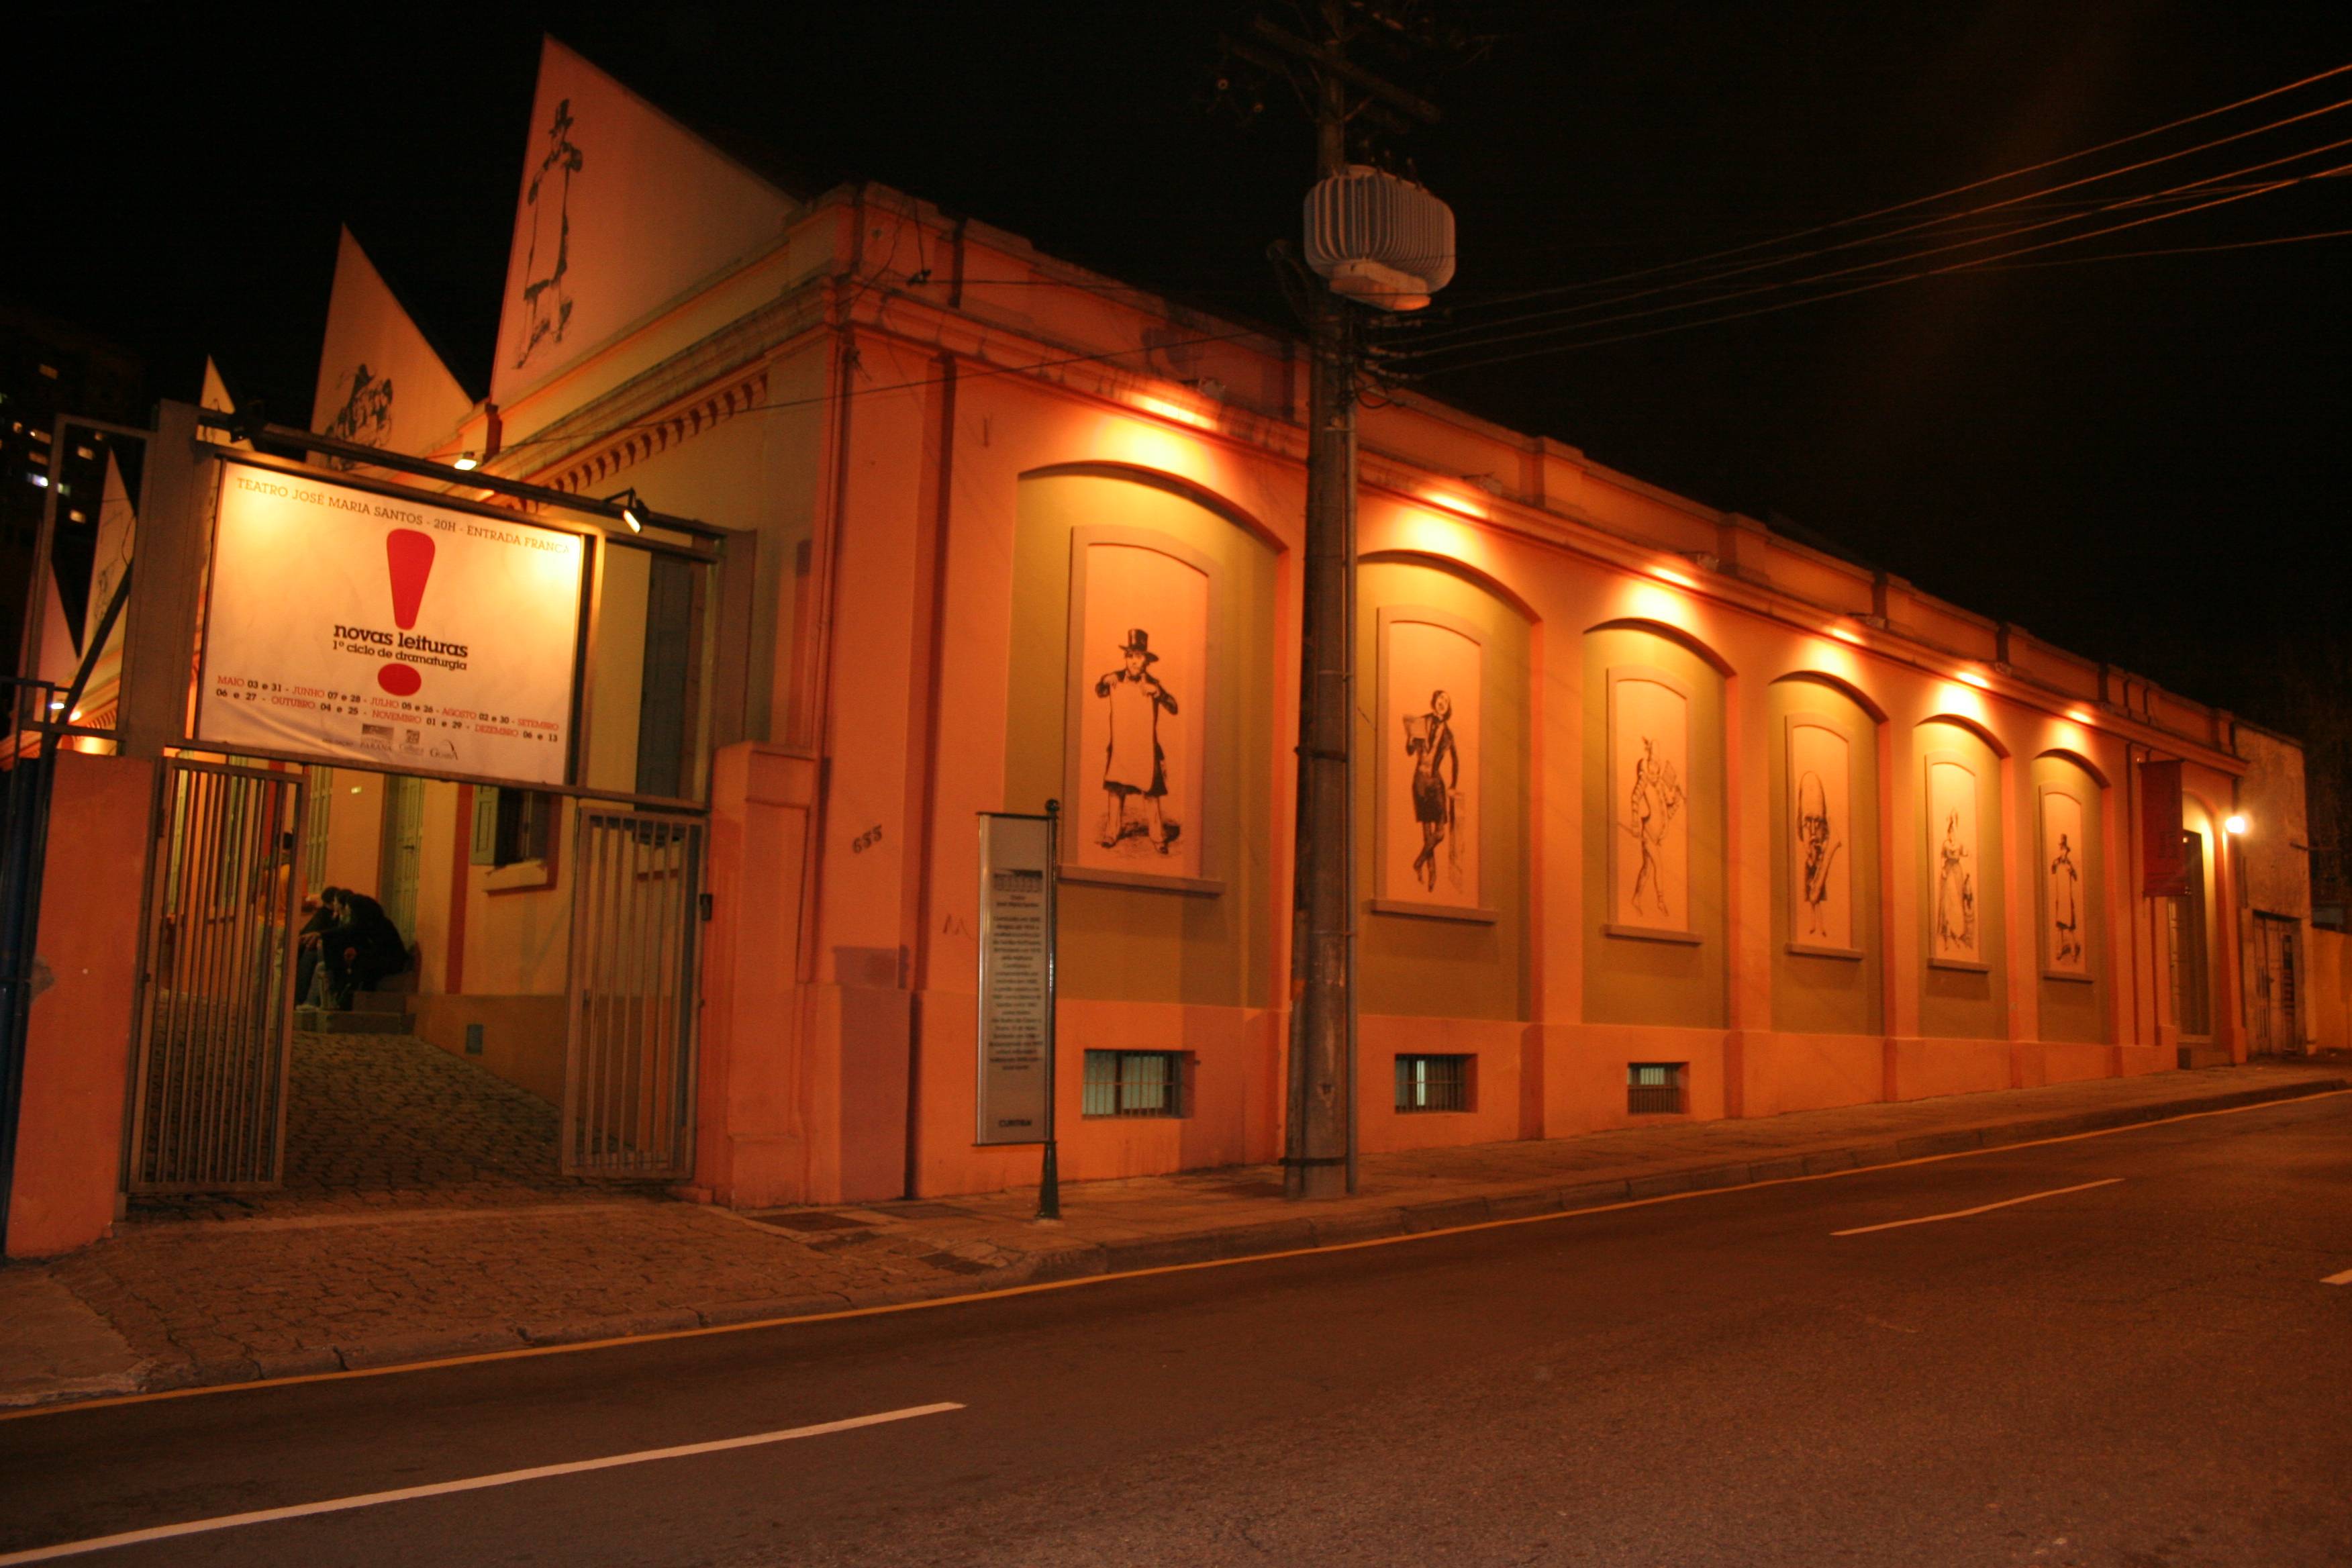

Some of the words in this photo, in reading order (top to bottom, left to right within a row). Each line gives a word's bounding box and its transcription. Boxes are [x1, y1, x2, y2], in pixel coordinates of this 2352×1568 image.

[237, 477, 289, 497] TEATRO
[292, 489, 325, 505] JOSÉ
[328, 497, 371, 515] MARIA
[373, 506, 424, 525] SANTOS
[434, 519, 456, 532] 20H
[467, 525, 521, 546] ENTRADA
[524, 537, 569, 554] FRANCA
[333, 624, 393, 646] novas
[398, 632, 469, 657] leituras
[346, 643, 375, 656] ciclo
[377, 648, 393, 658] de
[395, 650, 467, 671] dramaturgia
[215, 689, 228, 697] 06
[245, 692, 257, 701] 27
[271, 695, 316, 709] OUTUBRO
[320, 703, 332, 712] 04
[372, 710, 422, 725] NOVEMBRO
[426, 718, 436, 726] 01
[475, 724, 519, 738] DEZEMBRO
[522, 731, 532, 740] 06
[548, 734, 558, 742] 13
[217, 675, 245, 687] MAIO
[247, 679, 258, 689] 03
[271, 683, 282, 692] 31
[292, 686, 326, 699] JUNHO
[327, 691, 338, 699] 07
[350, 694, 361, 703] 28
[370, 697, 399, 709] JULHO
[423, 705, 433, 713] 26
[442, 707, 477, 720] AGOSTO
[479, 713, 489, 722] 02
[499, 716, 509, 724] 30
[518, 718, 559, 731] SETEMBRO
